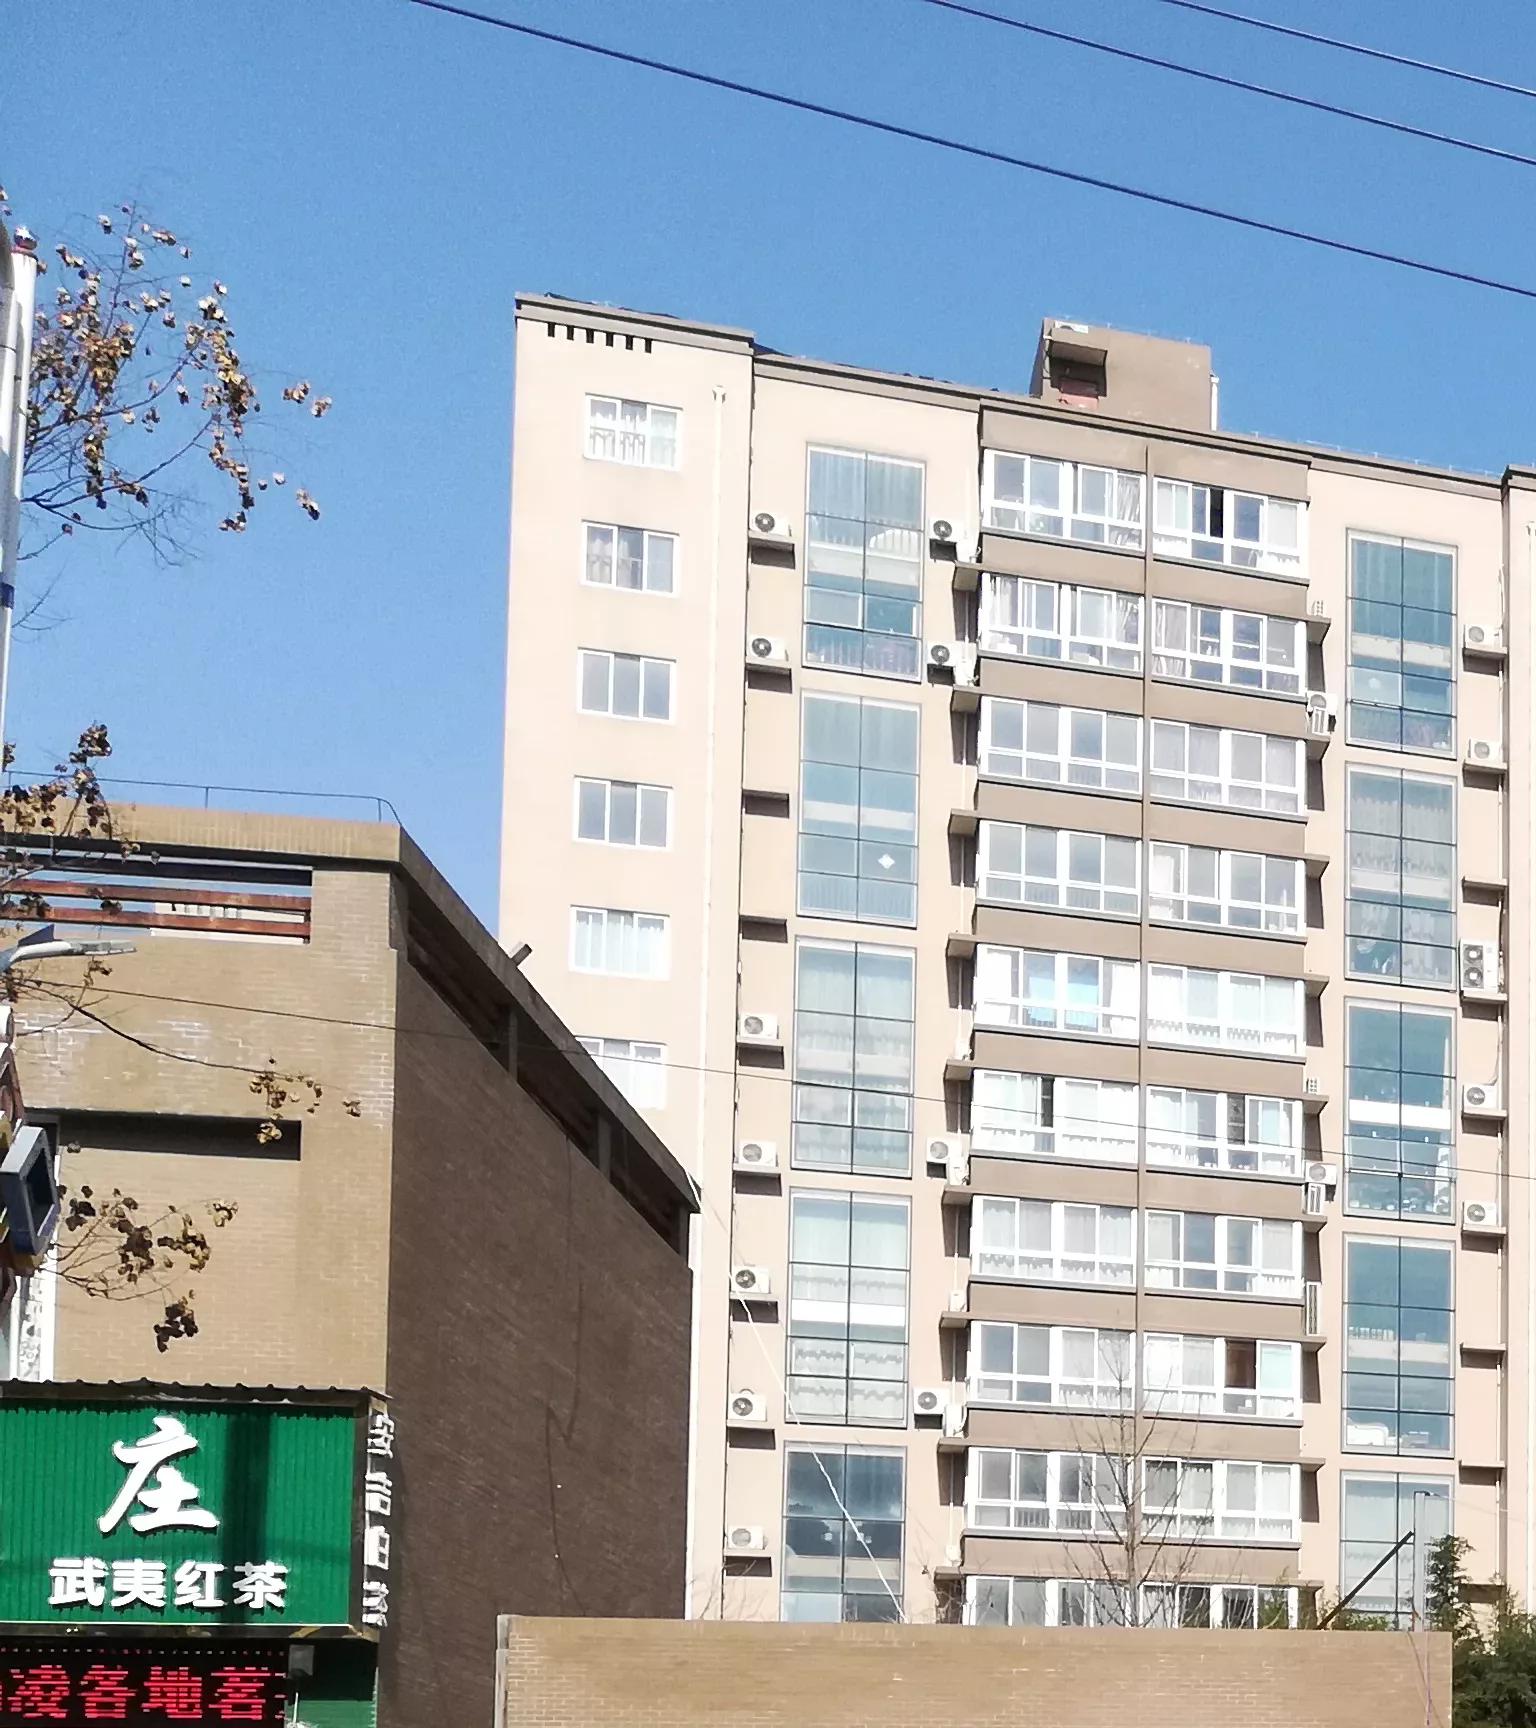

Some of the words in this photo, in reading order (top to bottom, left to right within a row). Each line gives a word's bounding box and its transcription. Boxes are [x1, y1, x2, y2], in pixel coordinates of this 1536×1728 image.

[97, 1414, 221, 1534] 庄
[48, 1557, 289, 1609] 武夷红茶
